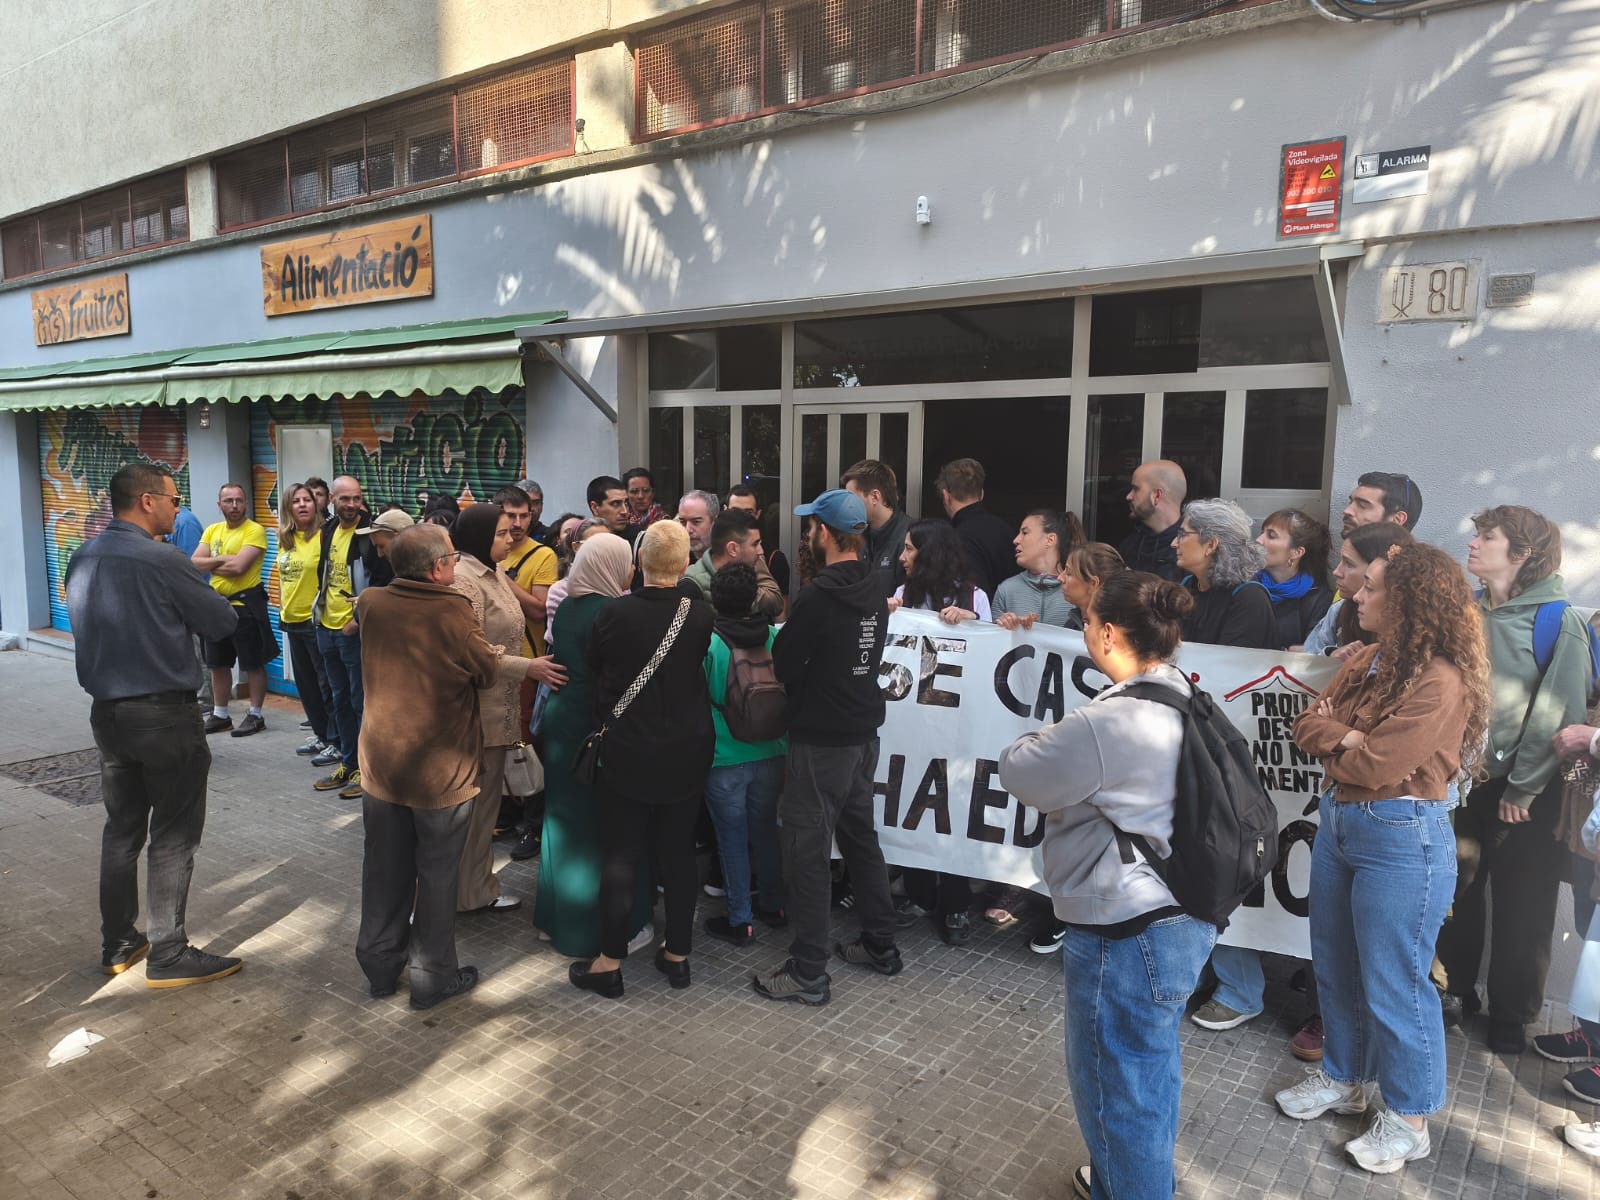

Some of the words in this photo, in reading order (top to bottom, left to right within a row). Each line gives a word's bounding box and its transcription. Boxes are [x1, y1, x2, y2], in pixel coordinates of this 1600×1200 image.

[1288, 151, 1307, 159] Zona
[1288, 153, 1338, 166] Videovigilada
[1382, 153, 1427, 168] ALARMA
[281, 224, 422, 303] Alimentació
[1428, 267, 1467, 314] 80
[69, 288, 125, 339] Fruites
[1253, 740, 1283, 766] NO
